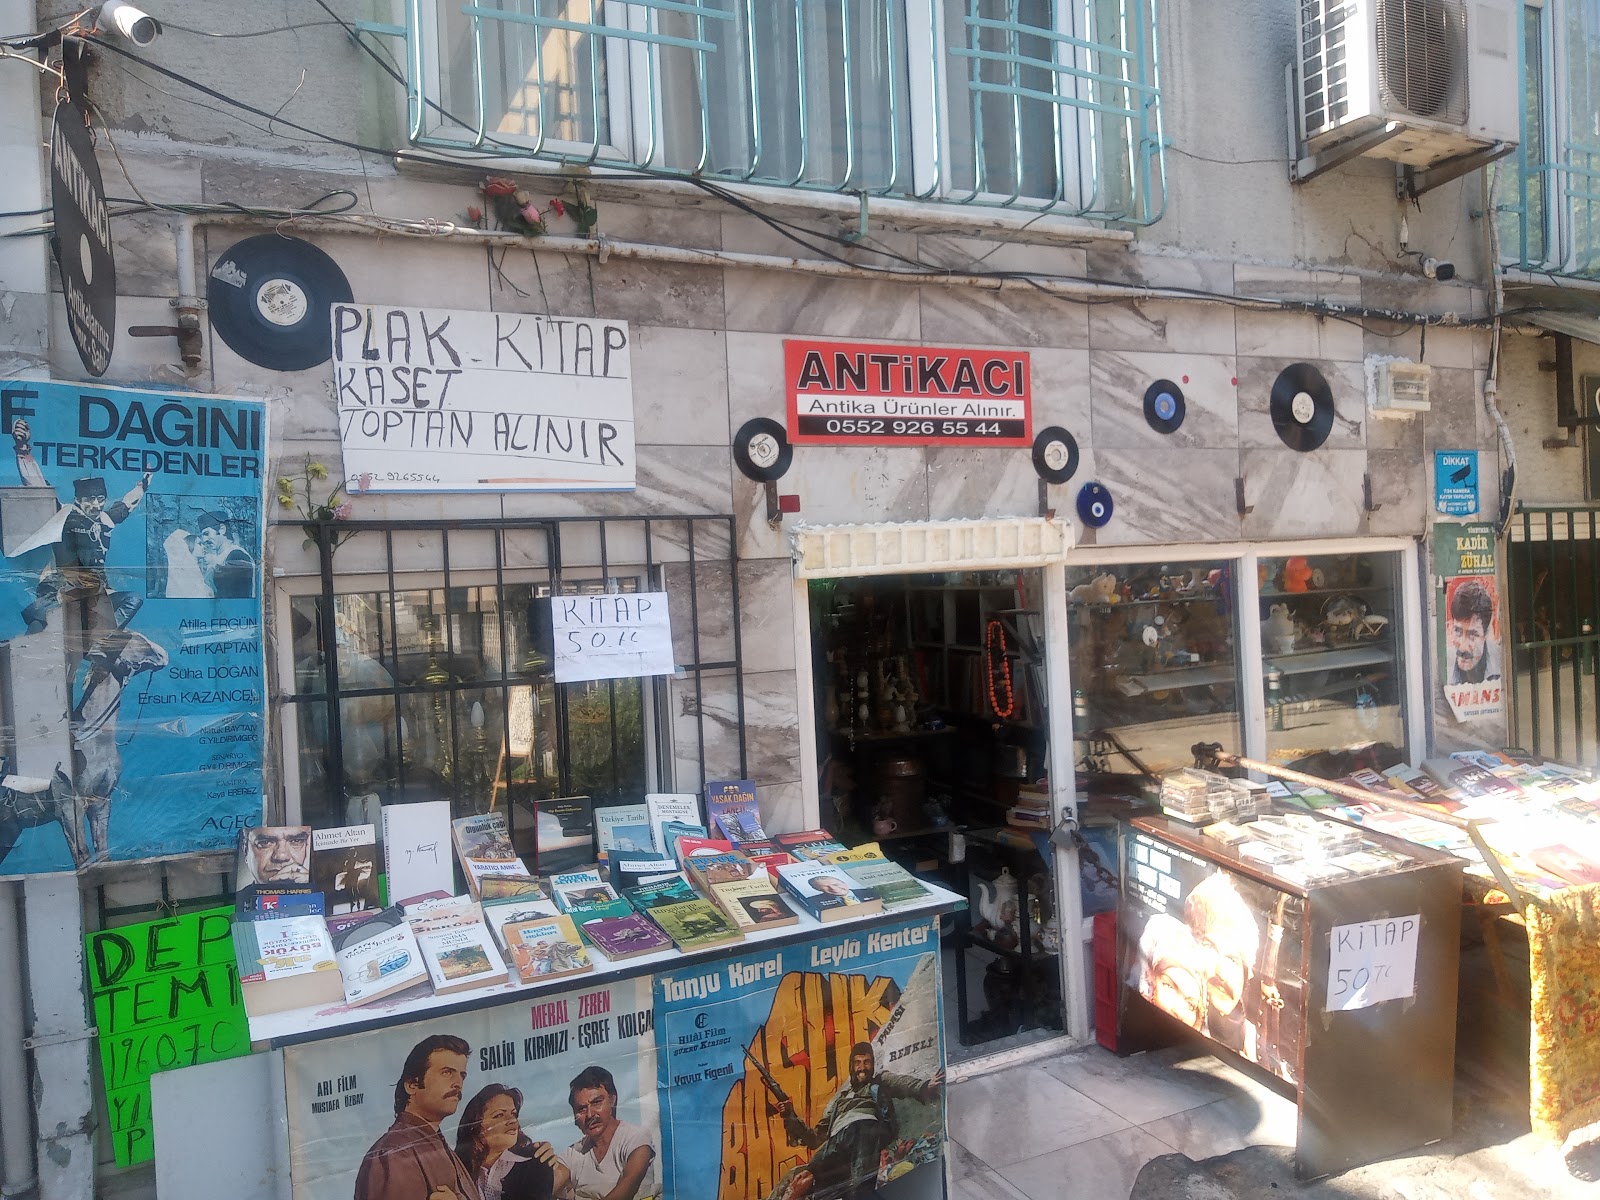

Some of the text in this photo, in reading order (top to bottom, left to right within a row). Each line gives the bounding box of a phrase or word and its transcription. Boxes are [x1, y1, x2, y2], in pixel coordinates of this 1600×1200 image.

[334, 305, 627, 378] PLAK KİTAP
[338, 366, 463, 410] KASET
[809, 398, 1016, 418] Antika Ürünler Alınır.
[79, 395, 261, 450] DAĞINI
[826, 419, 1001, 435] 0552 926 55 44
[341, 408, 624, 467] TOPTAN ALINIR
[33, 441, 260, 479] TERKEDENLER
[1442, 455, 1470, 466] DİKKAT
[350, 471, 440, 484] 052 9265544
[1456, 535, 1488, 551] KADİR
[1461, 552, 1494, 568] ZÜHAL
[179, 616, 258, 630] Atilla ERGÜN
[562, 596, 652, 626] KİTAP
[204, 641, 258, 655] KAPTAN
[169, 666, 203, 679] Süha
[138, 692, 177, 704] Ersun
[711, 794, 733, 803] YASAK
[600, 816, 624, 824] Türkiye
[315, 829, 366, 841] Ahmet Altan
[1338, 920, 1414, 953] KİTAP
[92, 914, 233, 986] DEP
[661, 924, 930, 1003] Tanju Korel Leylâ Kenter
[1334, 967, 1370, 996] 50
[531, 989, 611, 1031] MERAL ZEREN
[678, 1027, 726, 1045] Hilâl Film
[877, 1004, 906, 1047] PARASI
[480, 1040, 516, 1072] SALİH
[523, 1029, 569, 1063] KIRMIZI
[577, 1018, 611, 1049] EŞREF
[889, 1036, 934, 1063] RENKLİ
[317, 1074, 357, 1097] ARI FİLM
[674, 1063, 734, 1087] Yavuz Figenli
[113, 1093, 152, 1132] YI
[311, 1099, 340, 1114] MUSTAFA
[126, 1128, 146, 1166] P
